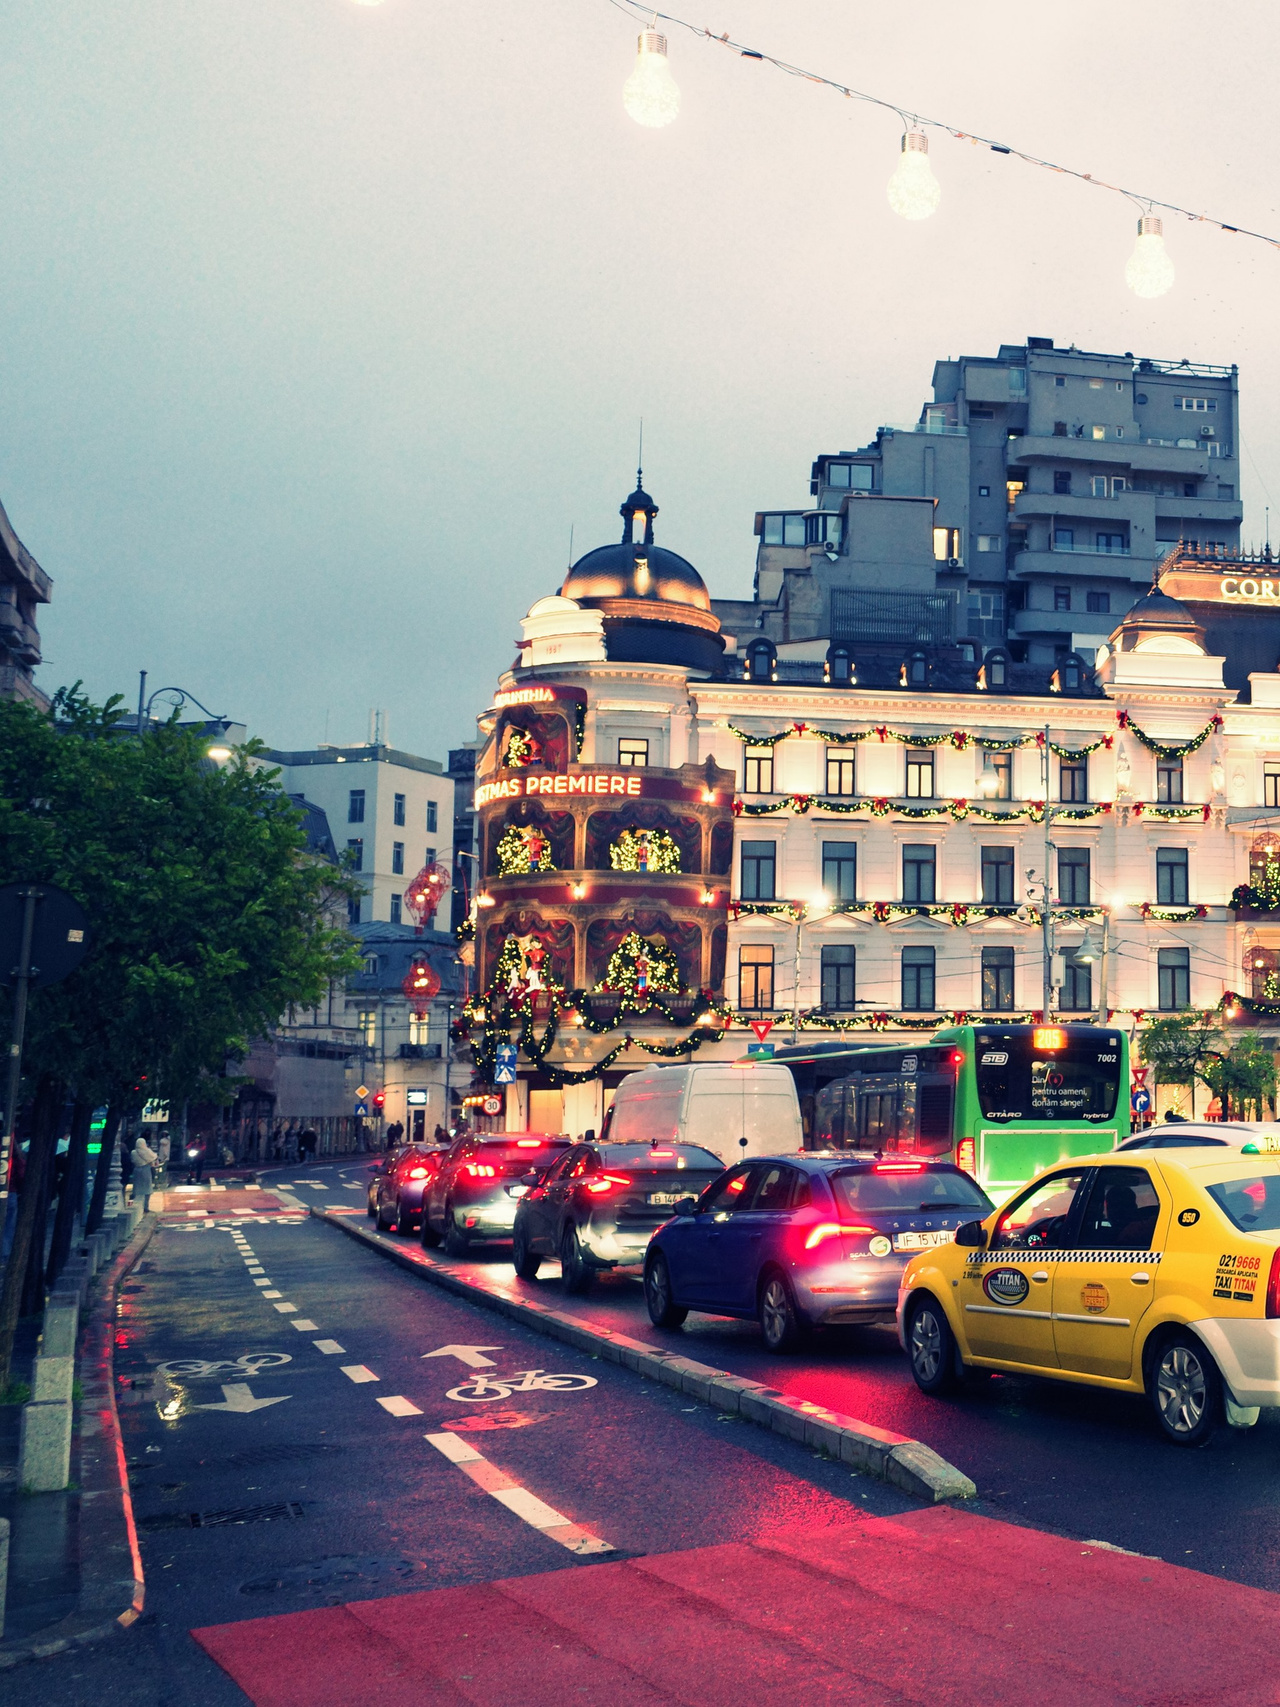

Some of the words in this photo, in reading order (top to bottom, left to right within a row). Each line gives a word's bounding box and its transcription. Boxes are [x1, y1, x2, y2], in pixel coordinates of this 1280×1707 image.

[526, 775, 641, 795] PREMIERE
[1037, 1029, 1060, 1048] 205
[981, 1053, 1007, 1064] STB
[1097, 1054, 1117, 1063] 7002
[1032, 1088, 1057, 1096] pentru
[1058, 1088, 1087, 1096] oameni,
[487, 1101, 498, 1110] 30
[654, 1196, 661, 1204] B
[1182, 1212, 1197, 1223] 950
[903, 1234, 913, 1246] IF
[918, 1234, 929, 1245] 15
[1216, 1268, 1236, 1276] DESCARCĂ
[997, 1273, 1021, 1286] TITAN
[1215, 1275, 1232, 1289] TAXI
[1234, 1278, 1257, 1291] TITAN
